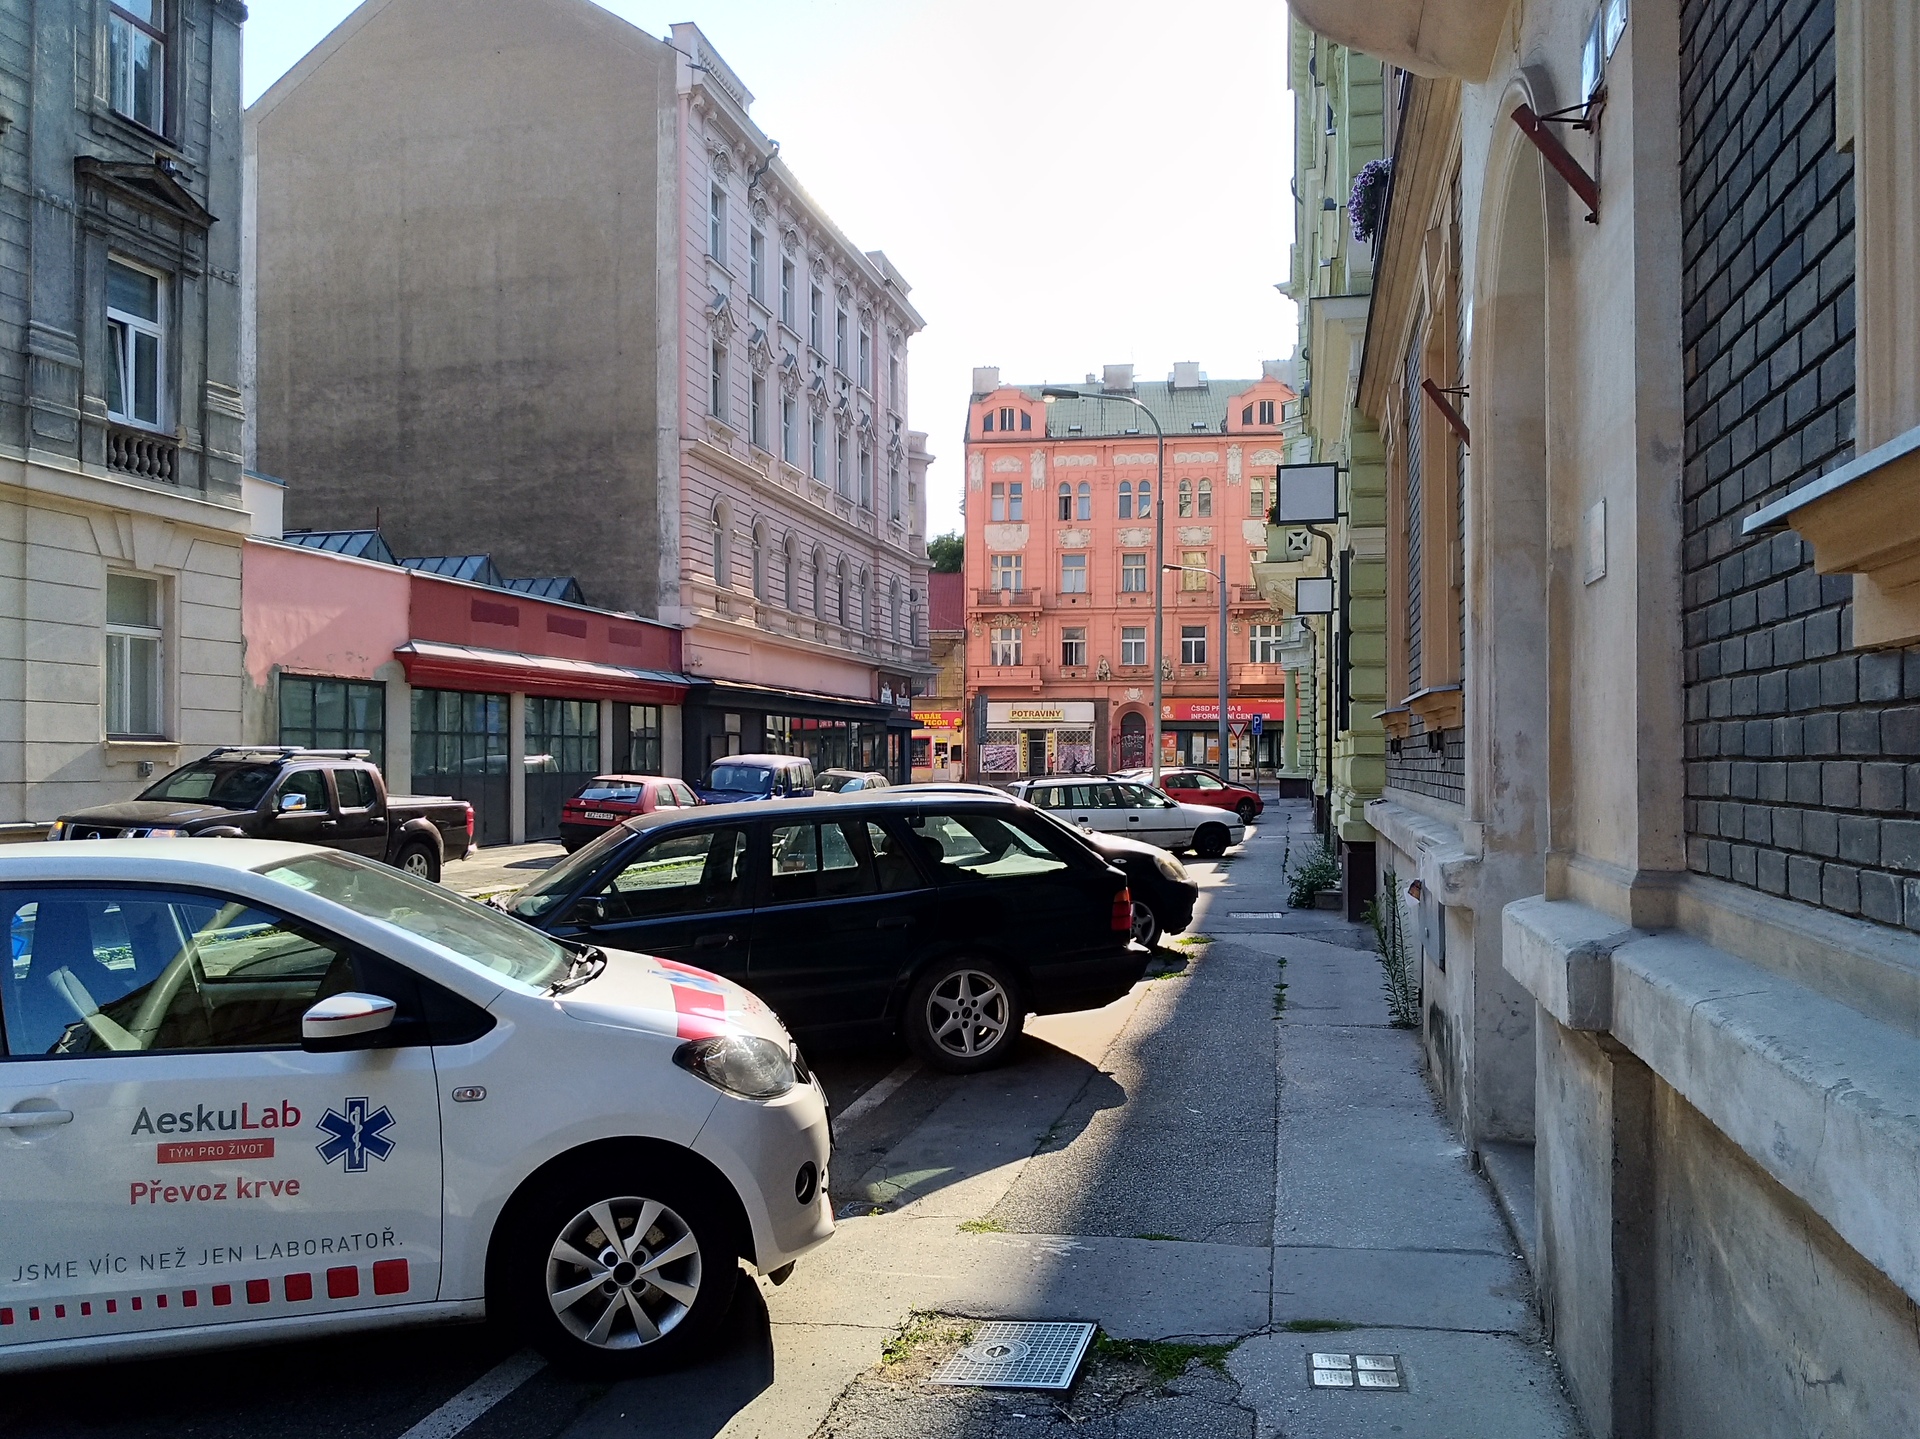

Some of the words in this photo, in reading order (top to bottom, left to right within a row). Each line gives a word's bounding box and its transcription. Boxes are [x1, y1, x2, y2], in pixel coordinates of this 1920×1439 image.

[1191, 704, 1211, 712] ČSSD
[1254, 716, 1260, 729] P
[131, 1100, 302, 1136] AeskuLab
[168, 1145, 195, 1159] TÝM
[198, 1145, 225, 1157] PRO
[228, 1141, 265, 1156] ŽIVOT
[129, 1178, 227, 1206] Převoz
[236, 1176, 301, 1200] krve
[12, 1260, 78, 1283] JSME
[88, 1252, 128, 1275] VÍC
[139, 1247, 187, 1271] NEŽ
[197, 1244, 243, 1267] JEN
[254, 1227, 404, 1261] LABORATOŘ.
